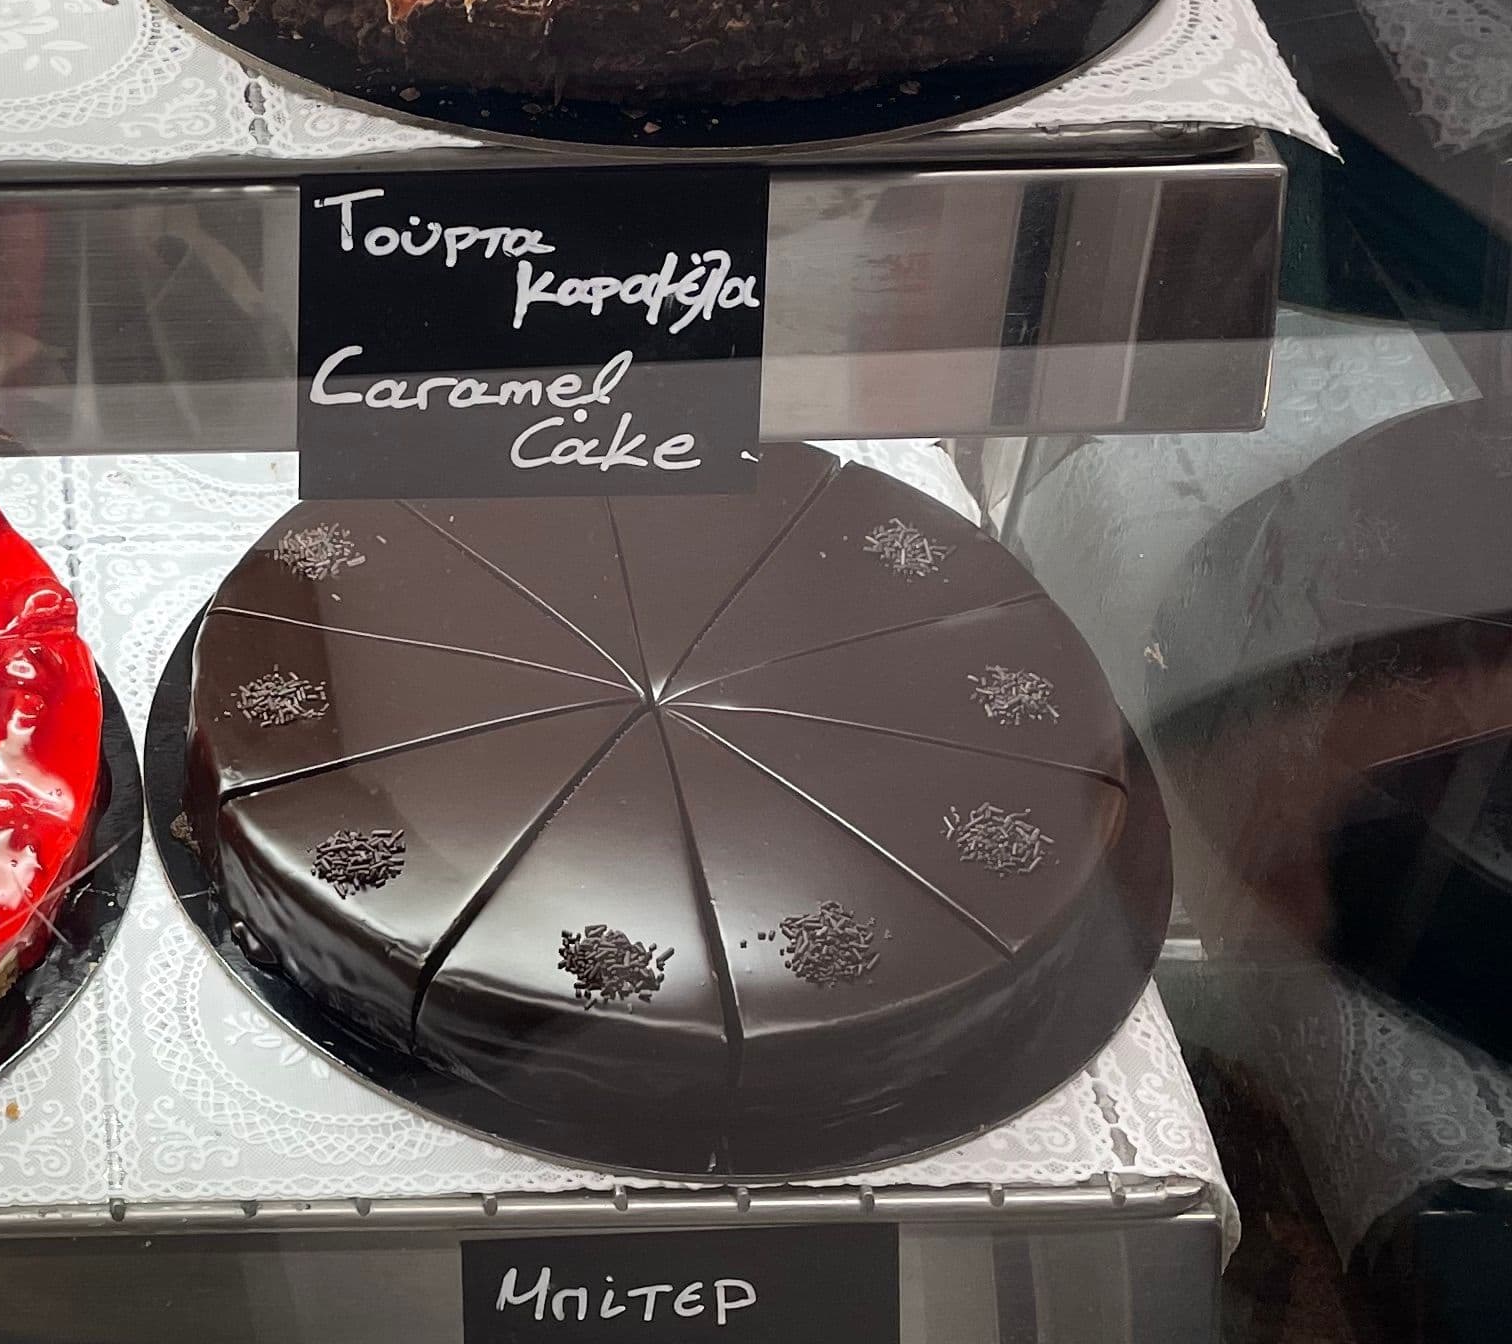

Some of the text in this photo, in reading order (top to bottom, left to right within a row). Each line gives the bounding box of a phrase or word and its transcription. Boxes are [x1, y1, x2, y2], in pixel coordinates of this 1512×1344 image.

[314, 188, 556, 267] Τούρτα
[310, 345, 633, 410] Caramel
[510, 412, 702, 472] Cake
